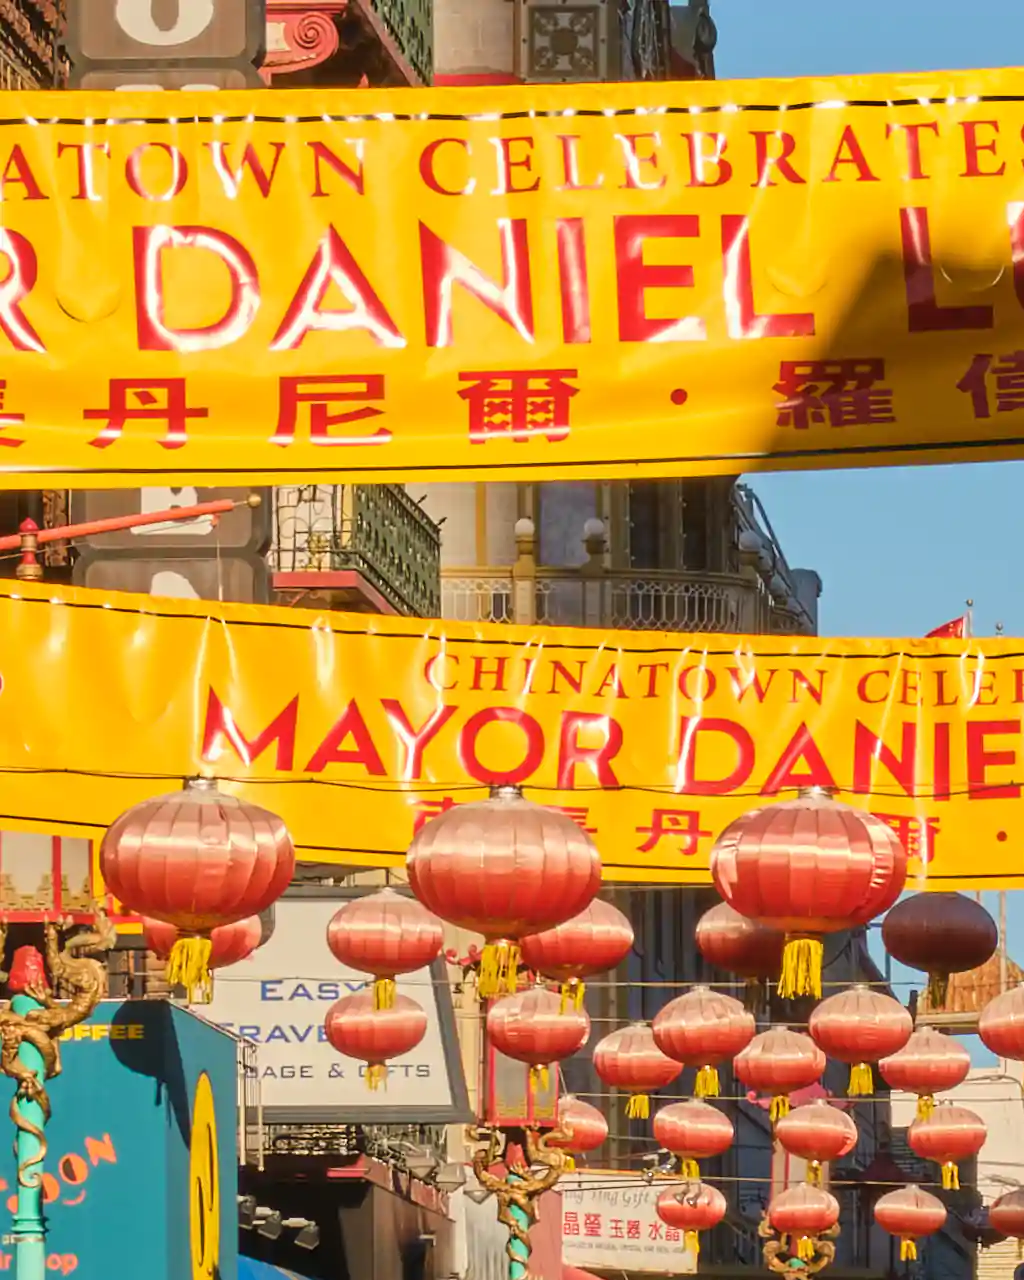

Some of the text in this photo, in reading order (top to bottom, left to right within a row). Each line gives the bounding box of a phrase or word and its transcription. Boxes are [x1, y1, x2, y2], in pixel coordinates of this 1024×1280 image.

[131, 213, 815, 353] DANIEL
[423, 653, 827, 704] CHINATOWN
[201, 684, 623, 790] MAYOR
[328, 1063, 344, 1079] &
[358, 1063, 431, 1079] GFTS
[608, 1218, 641, 1240] 玉器
